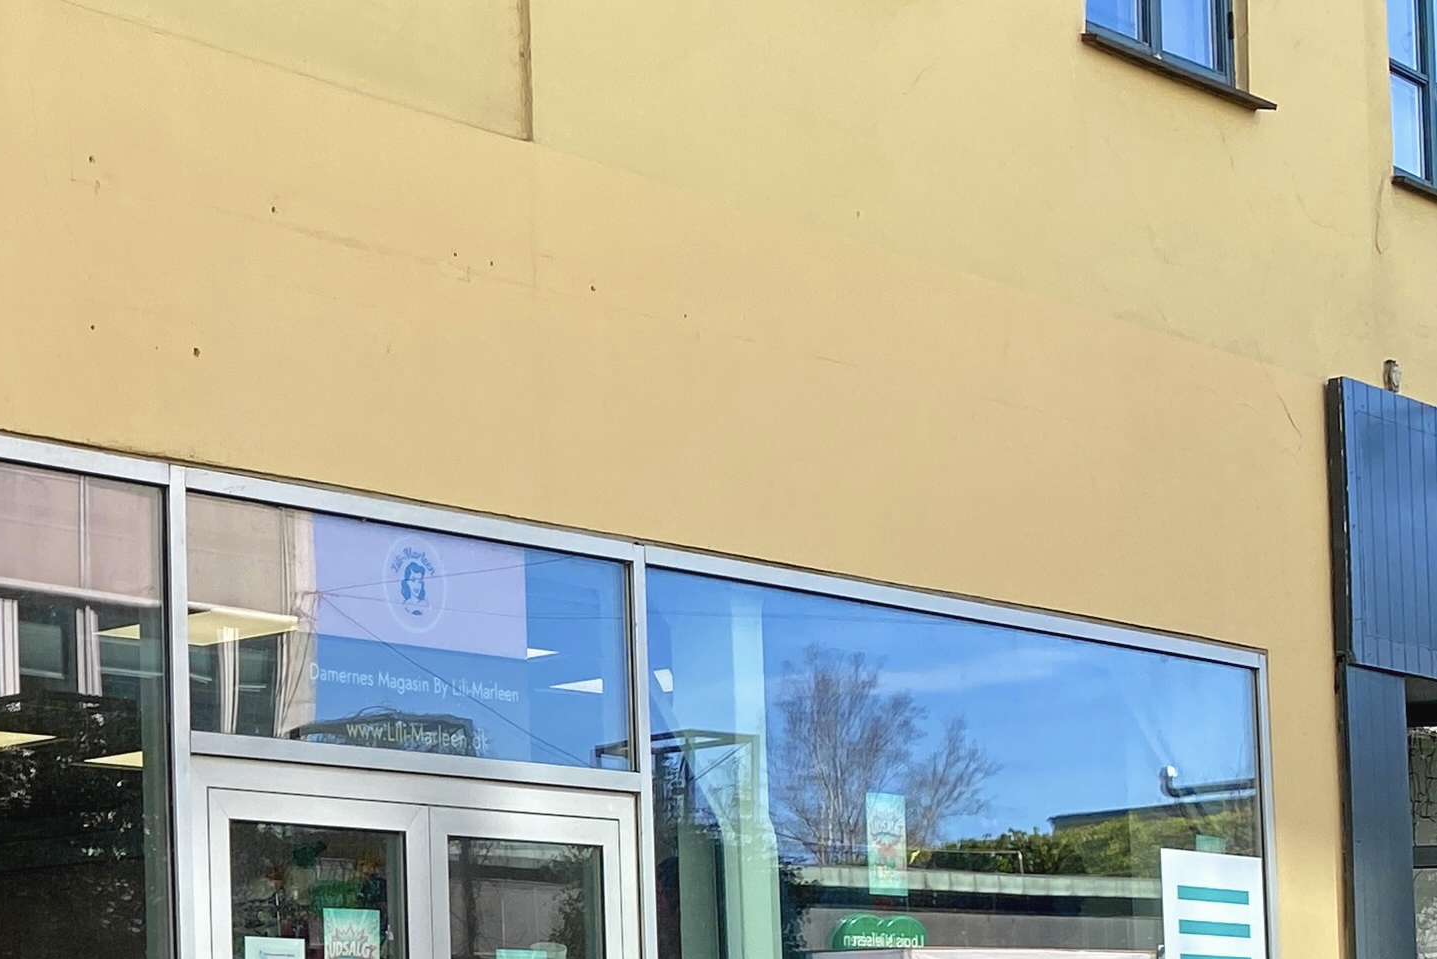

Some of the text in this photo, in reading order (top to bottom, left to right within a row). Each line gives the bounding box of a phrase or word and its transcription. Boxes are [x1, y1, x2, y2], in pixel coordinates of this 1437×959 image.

[309, 662, 519, 703] Damernes Magasin By Lili-Marleen
[328, 938, 371, 959] UDSALG
